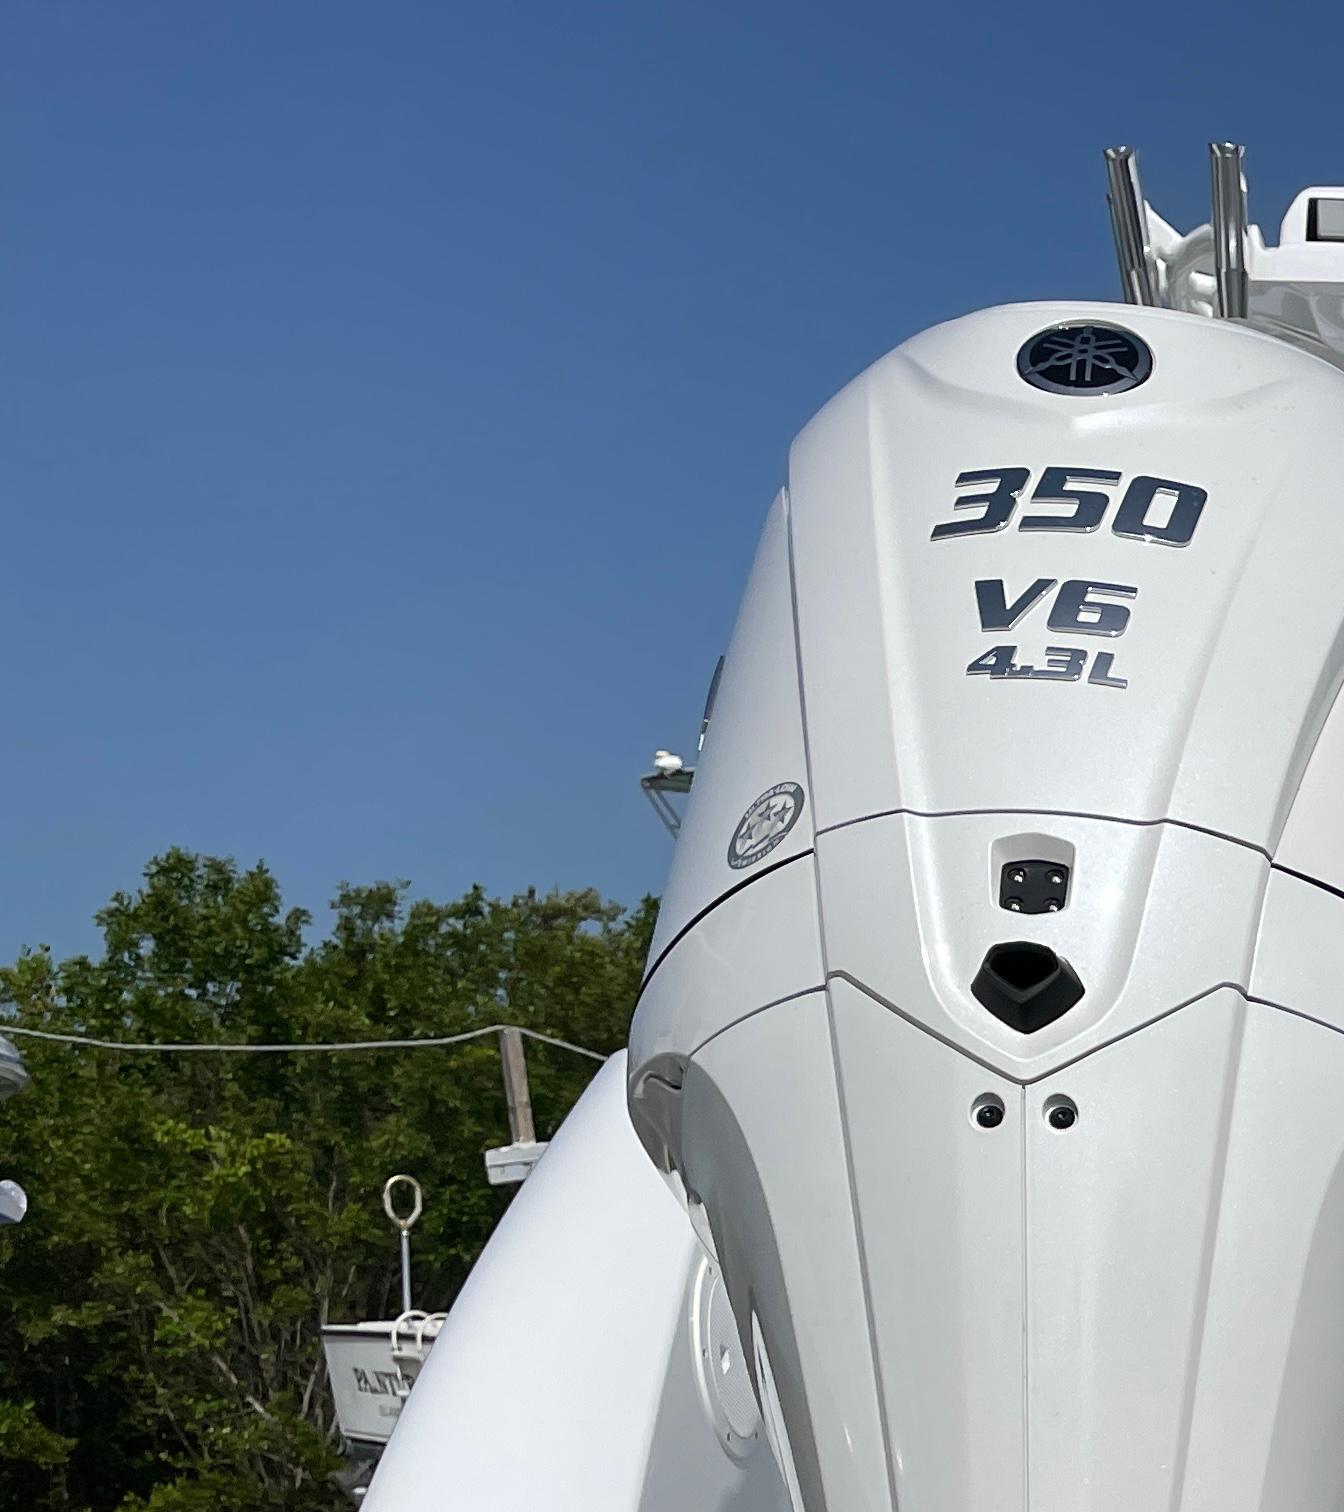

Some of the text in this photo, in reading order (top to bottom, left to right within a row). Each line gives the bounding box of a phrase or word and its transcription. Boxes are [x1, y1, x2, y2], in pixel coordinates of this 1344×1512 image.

[930, 466, 1207, 548] 350
[975, 578, 1138, 637] V6
[966, 645, 1128, 689] 4.3L
